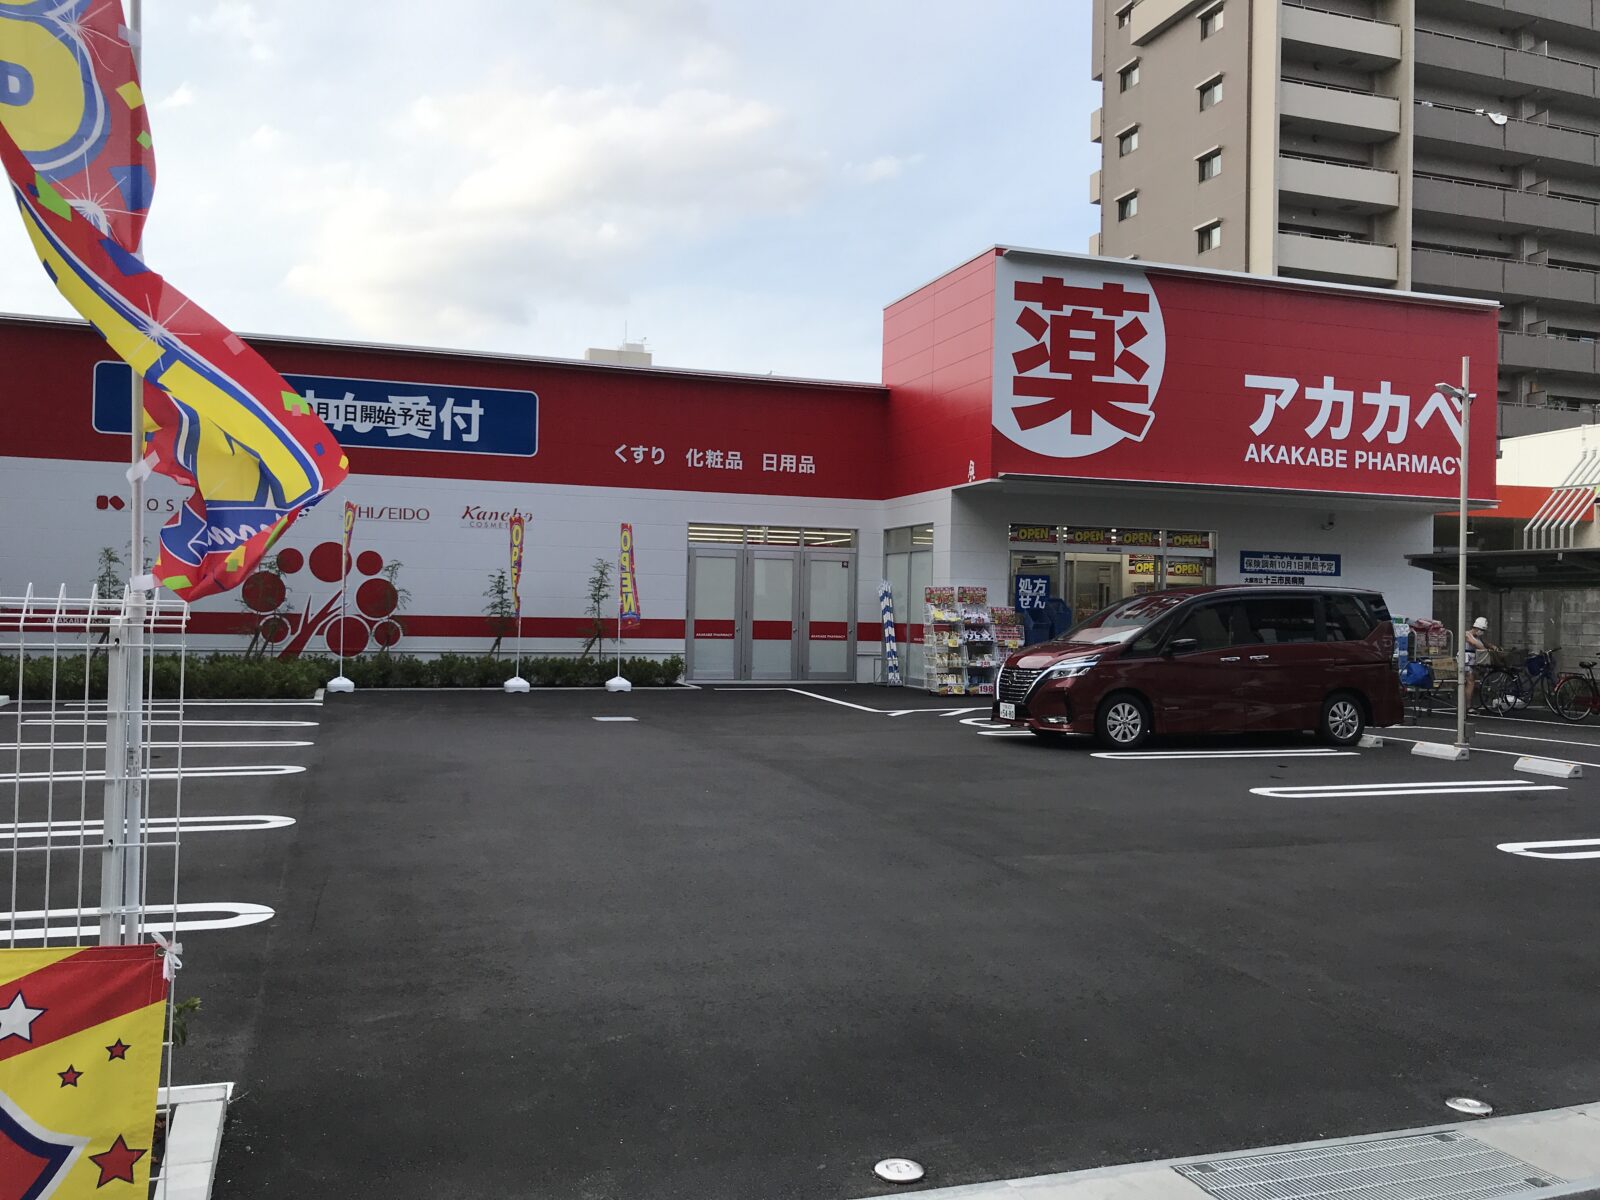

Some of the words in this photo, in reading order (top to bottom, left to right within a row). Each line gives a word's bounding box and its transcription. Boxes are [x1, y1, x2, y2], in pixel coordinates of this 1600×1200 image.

[1011, 276, 1151, 438] 薬
[308, 401, 433, 427] 月1日開始予定
[1245, 374, 1464, 447] アカカベ
[614, 444, 665, 465] くすり
[686, 448, 743, 470] 化粧品
[762, 453, 816, 474] 日用品
[1245, 443, 1348, 469] AKAKABE
[339, 506, 430, 521] HISEIDO
[1018, 527, 1049, 540] OPEN
[1074, 530, 1104, 542] OPEN
[1123, 532, 1151, 544] OPEN
[1172, 534, 1202, 546] OPEN
[1174, 563, 1200, 574] OPEN
[1018, 578, 1048, 593] 処方
[1018, 595, 1046, 609] せん
